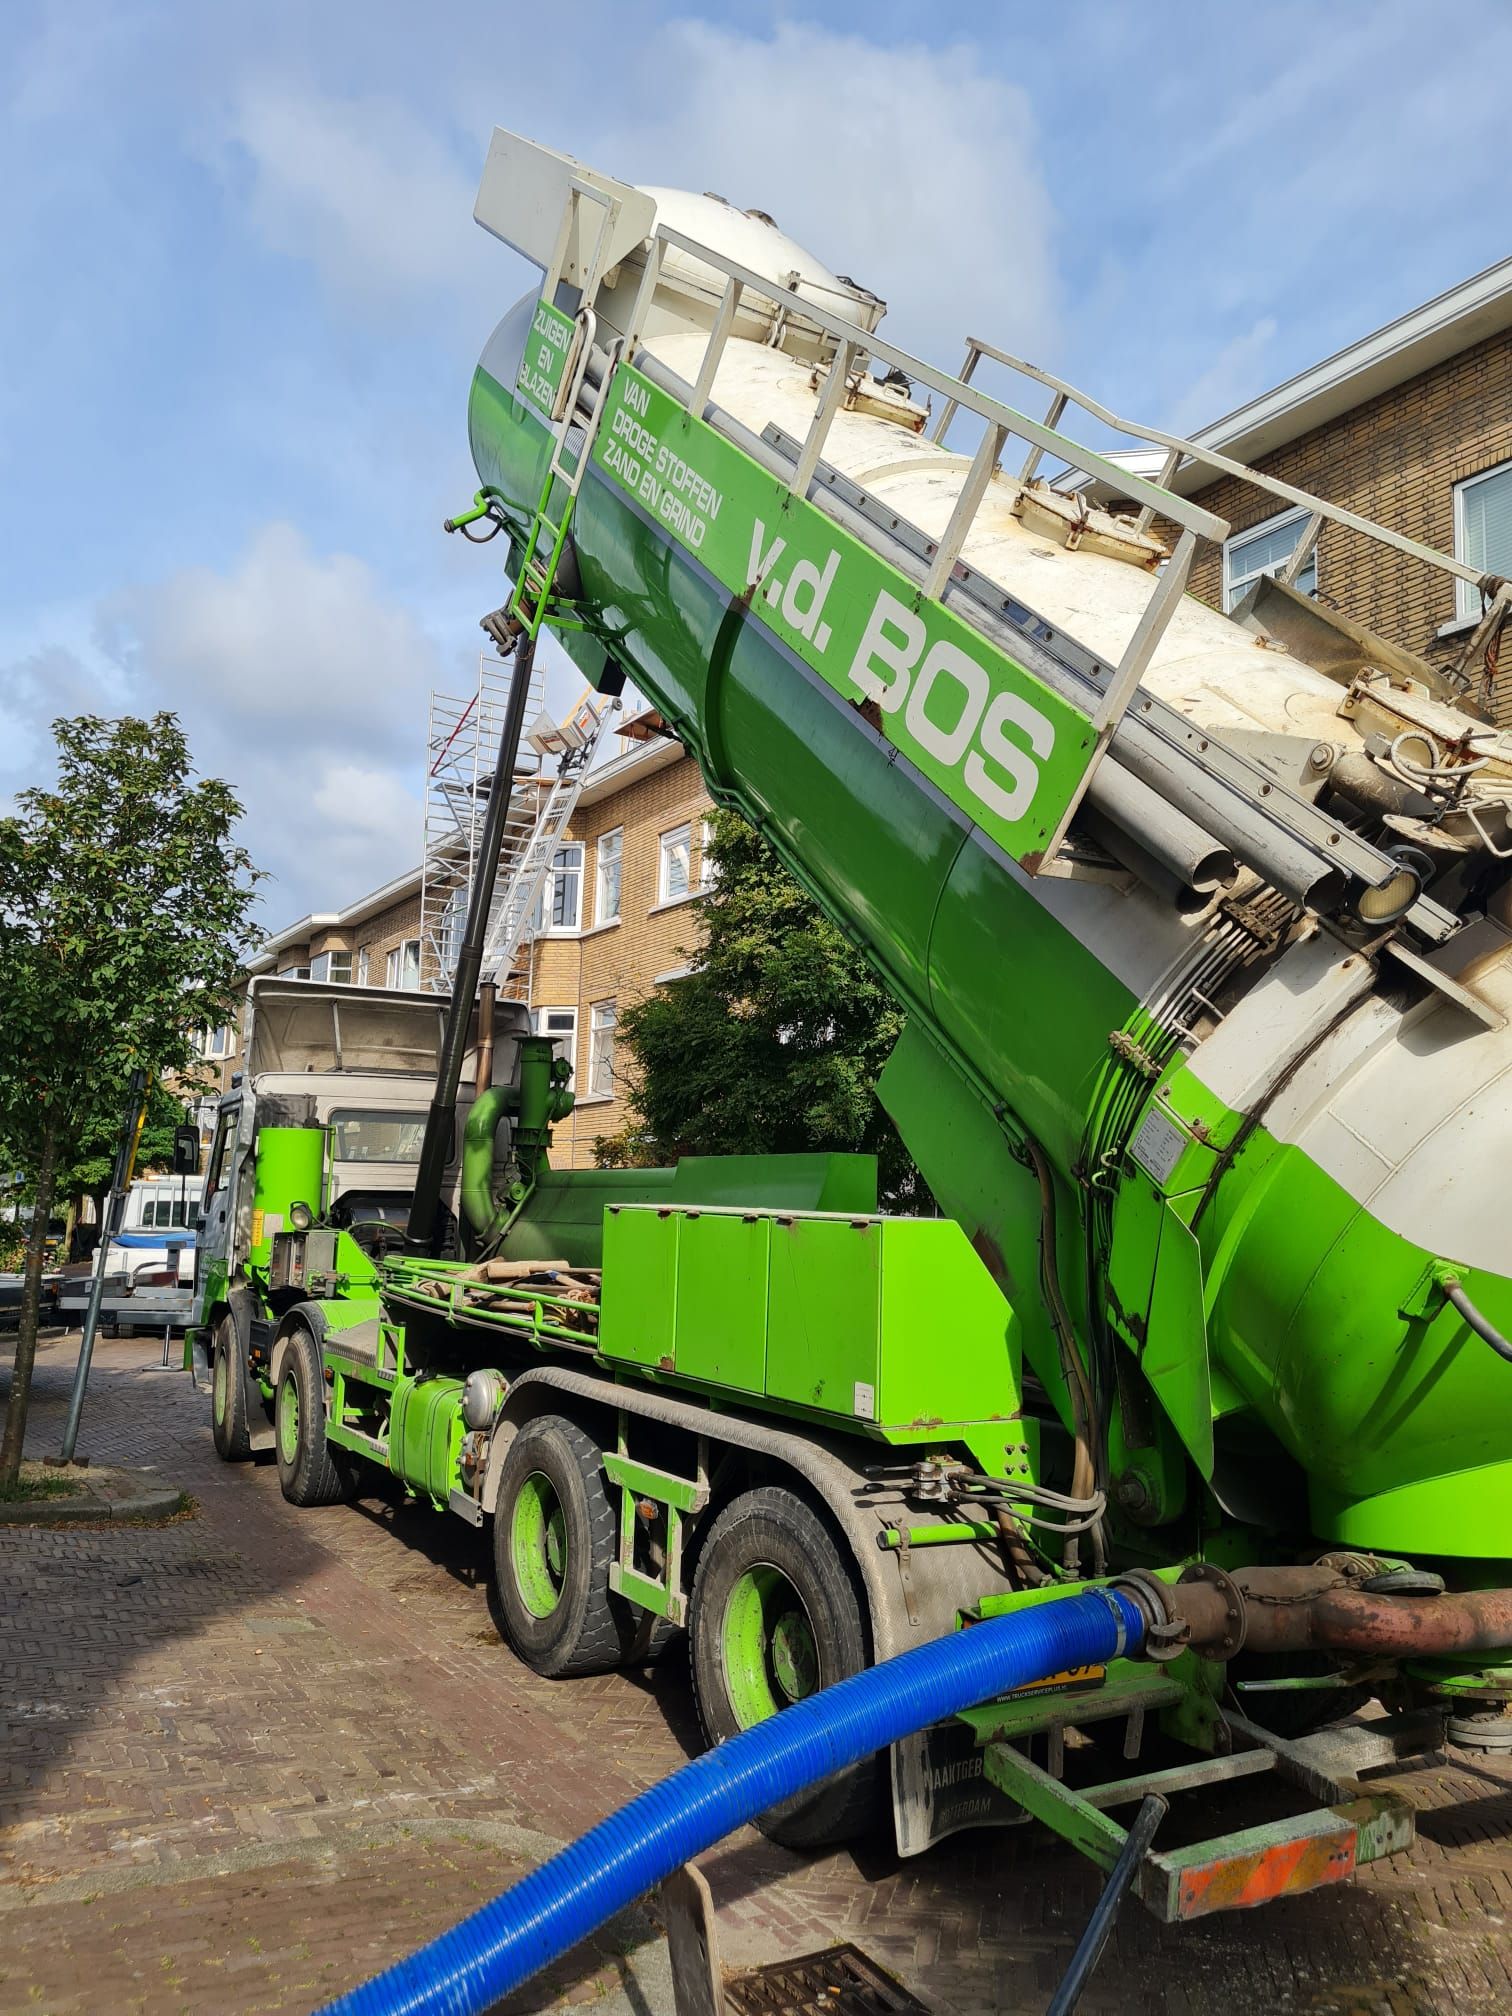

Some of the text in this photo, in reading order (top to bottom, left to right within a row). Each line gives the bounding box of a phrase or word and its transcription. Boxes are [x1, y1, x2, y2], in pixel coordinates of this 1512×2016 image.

[533, 308, 572, 353] ZUIGEN
[537, 344, 555, 374] EN
[518, 361, 557, 413] BLAZEN
[623, 376, 651, 418] VAN
[611, 407, 723, 520] DROGE STOFFEN
[602, 437, 706, 548] ZAND EN GRIND
[848, 588, 1056, 822] BOS
